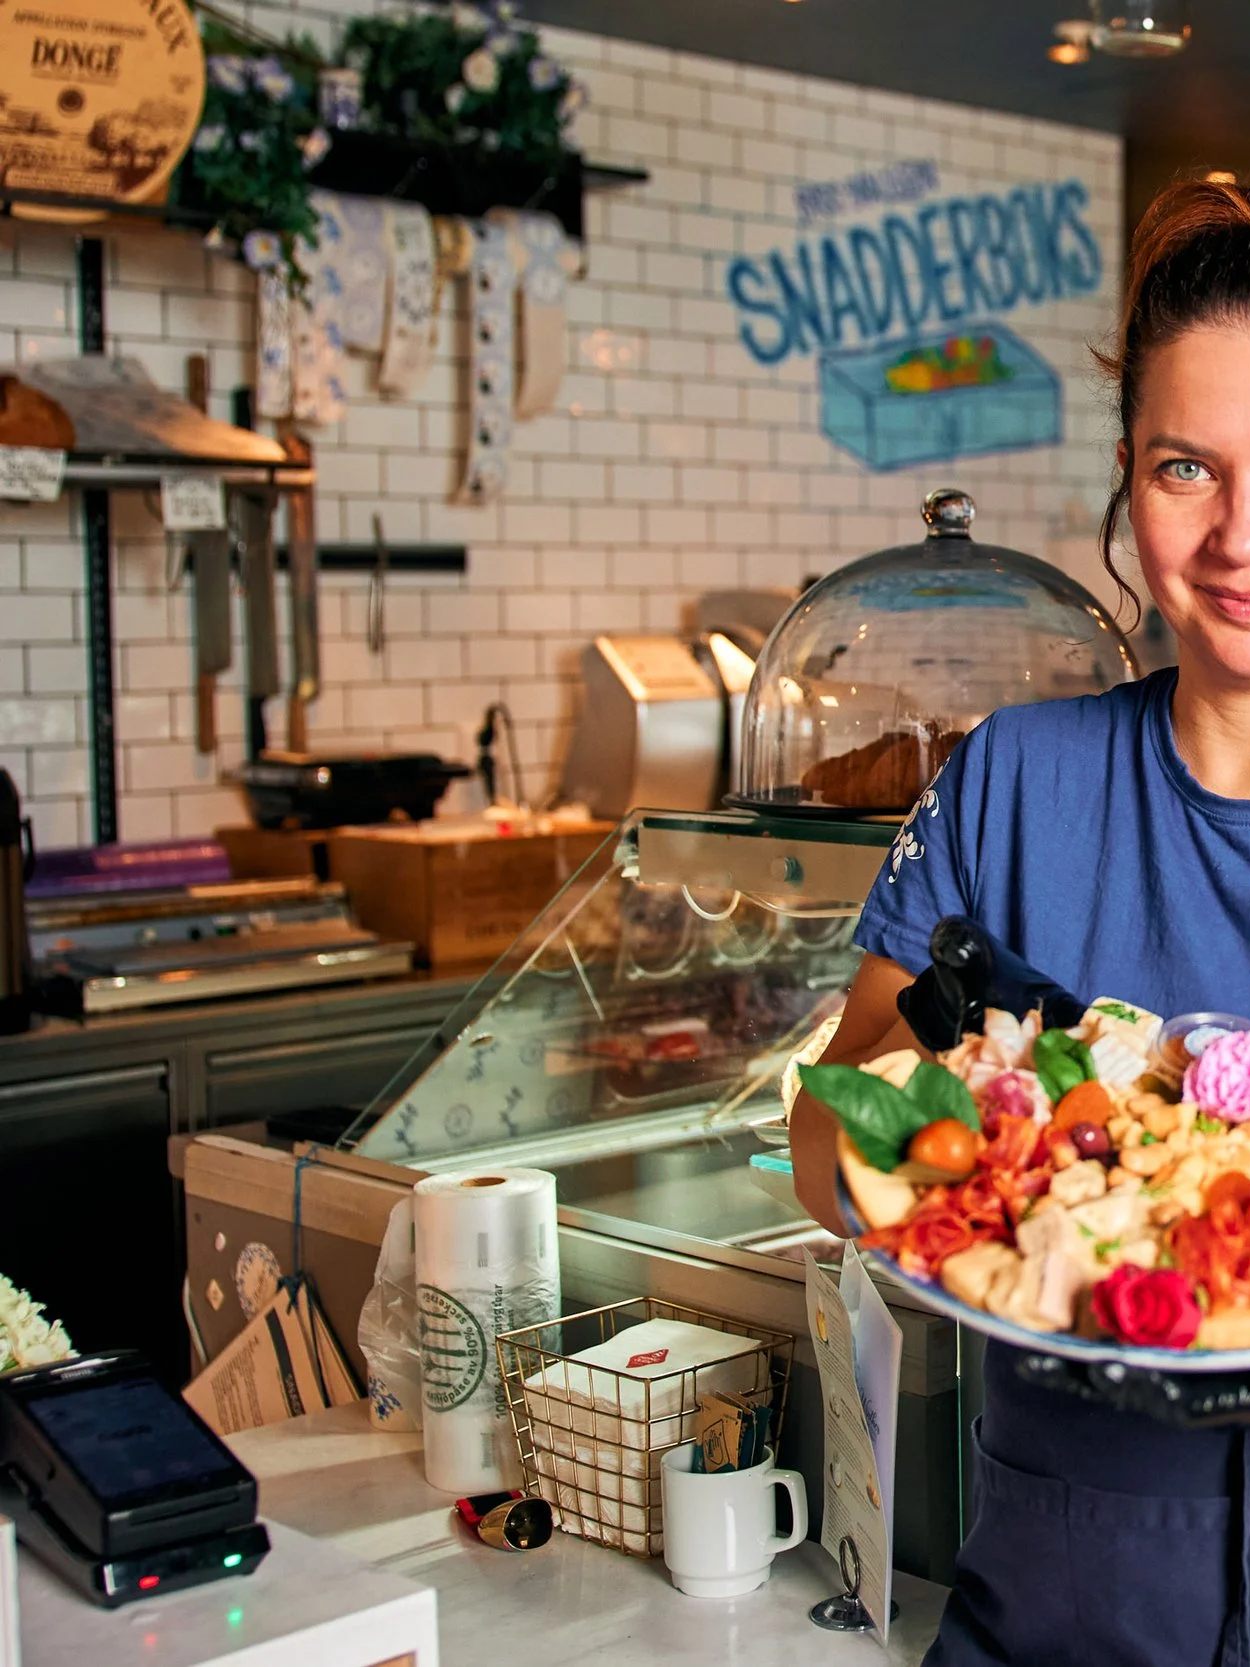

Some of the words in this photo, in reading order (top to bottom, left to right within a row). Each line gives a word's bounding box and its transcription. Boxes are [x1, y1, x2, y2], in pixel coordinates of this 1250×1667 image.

[727, 177, 1101, 366] SNADDERBOKS
[464, 1326, 478, 1357] 90%
[468, 1361, 478, 1376] av
